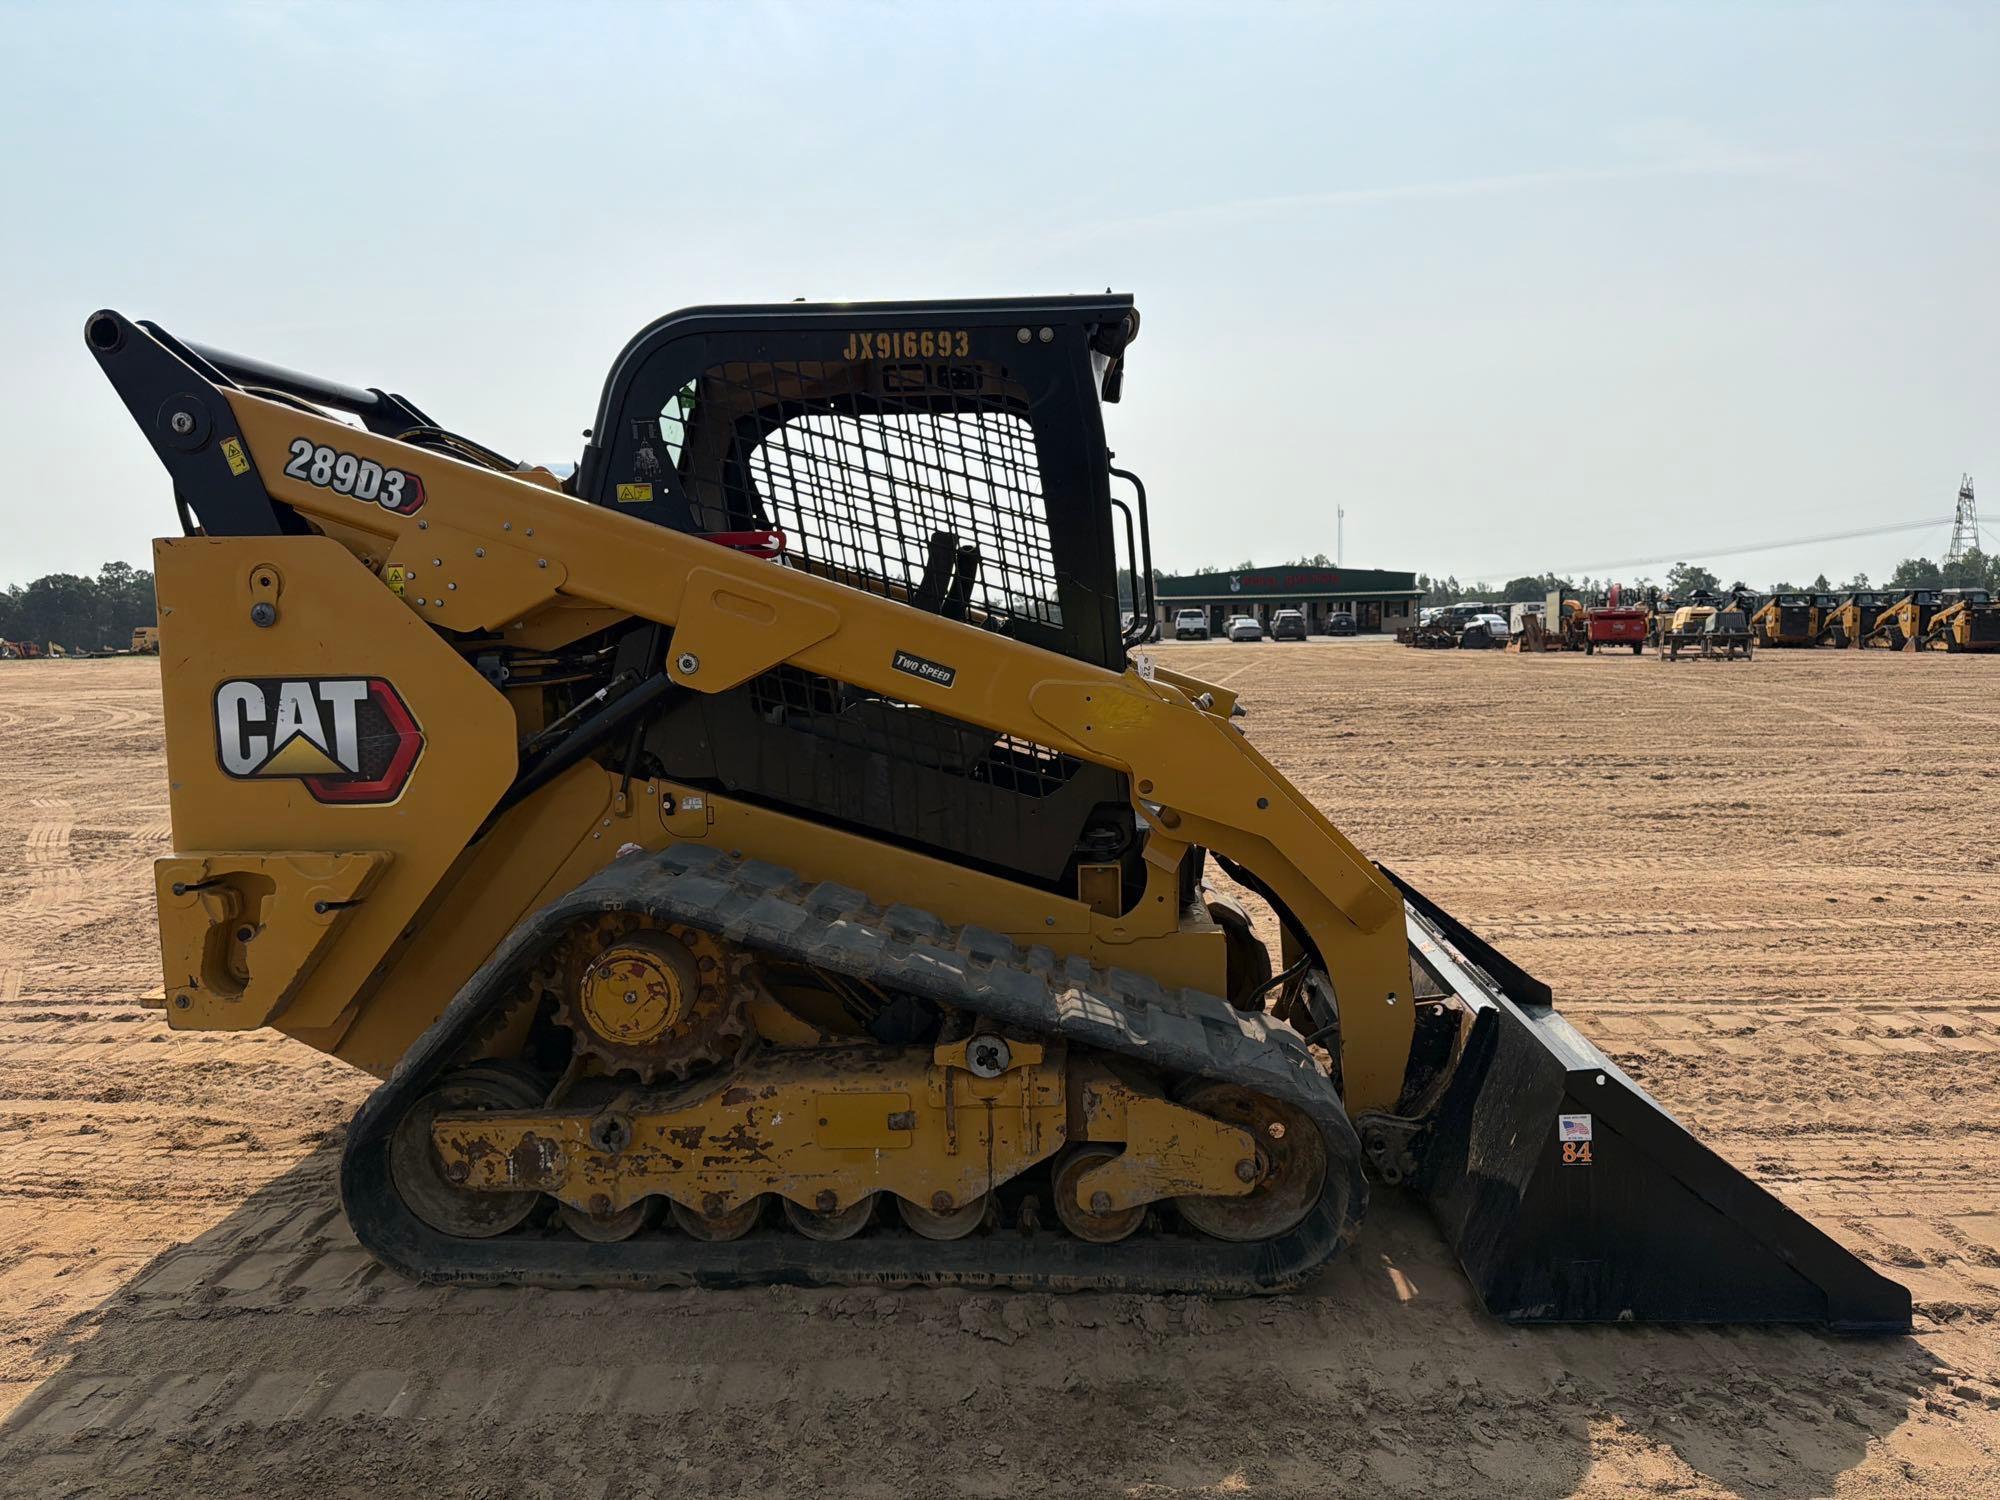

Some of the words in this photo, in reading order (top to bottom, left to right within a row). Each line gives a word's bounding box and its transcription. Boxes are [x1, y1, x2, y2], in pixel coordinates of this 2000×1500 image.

[843, 331, 969, 360] JX916693
[285, 440, 405, 508] 289D3
[217, 681, 368, 775] CAT
[1563, 1141, 1592, 1163] 84
